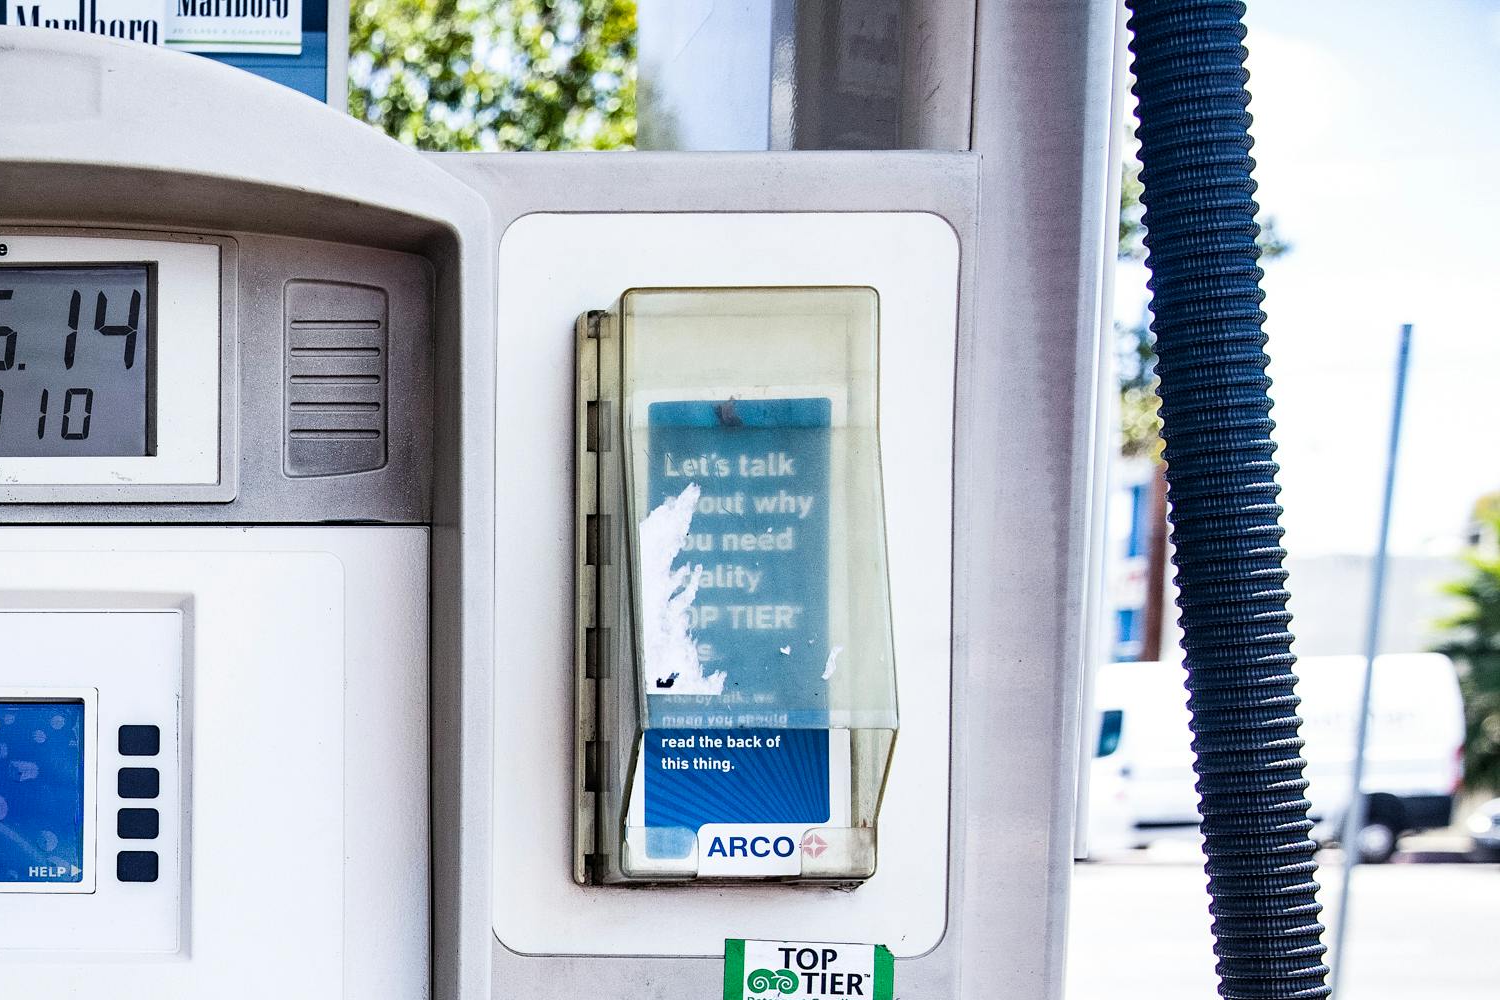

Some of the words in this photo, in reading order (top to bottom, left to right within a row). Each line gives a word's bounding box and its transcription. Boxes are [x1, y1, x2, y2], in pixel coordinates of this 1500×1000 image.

[232, 28, 293, 36] CIGARETTES
[739, 453, 796, 477] talk
[661, 735, 695, 748] read
[699, 735, 722, 748] the
[727, 735, 762, 748] back
[766, 735, 781, 748] of
[661, 757, 689, 770] this
[693, 757, 735, 772] thing.
[707, 836, 795, 858] ARCO
[29, 866, 67, 877] HELP
[778, 947, 838, 970] TOP
